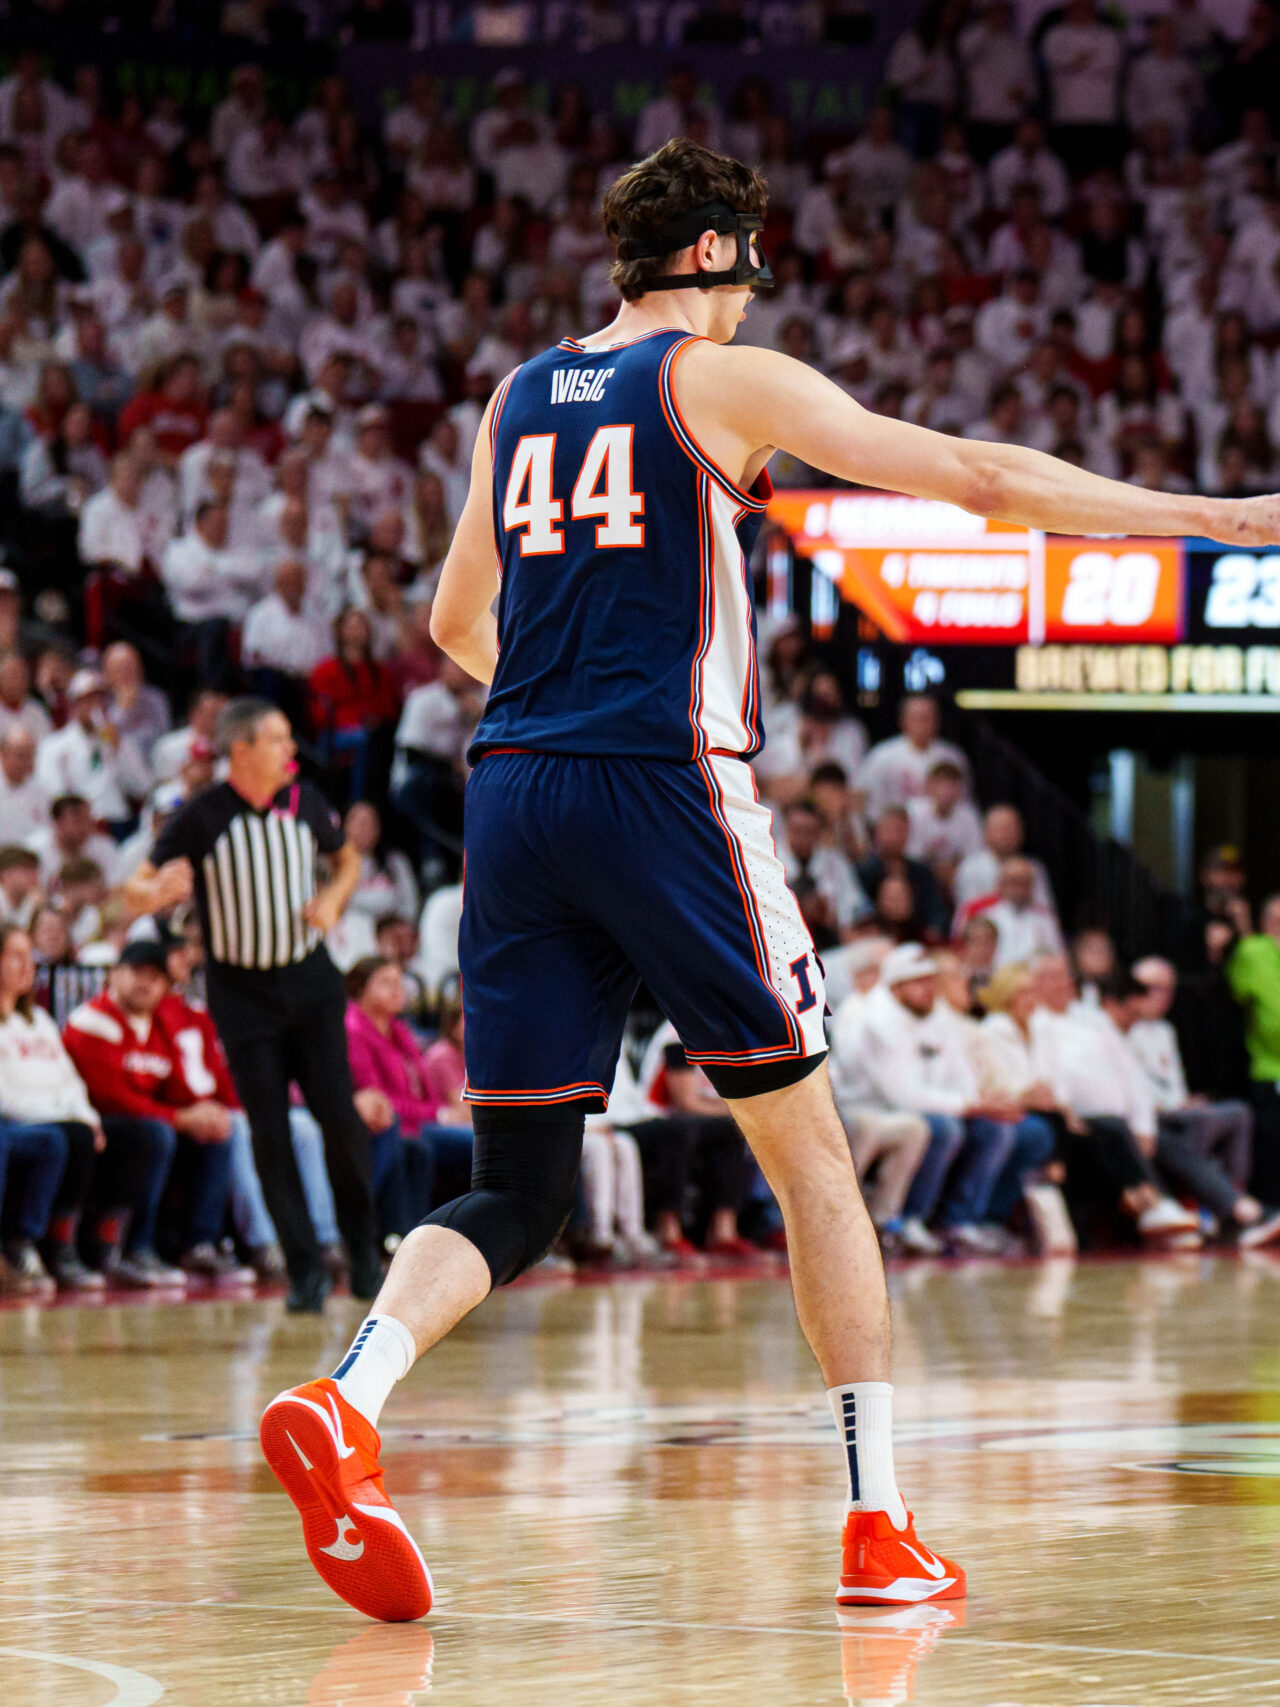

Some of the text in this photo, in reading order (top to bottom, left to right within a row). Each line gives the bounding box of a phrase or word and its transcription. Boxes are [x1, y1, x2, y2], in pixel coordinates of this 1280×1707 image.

[550, 368, 616, 404] IVISIC
[503, 424, 645, 558] 44
[1061, 552, 1162, 627] 20
[1171, 645, 1243, 693] FOR
